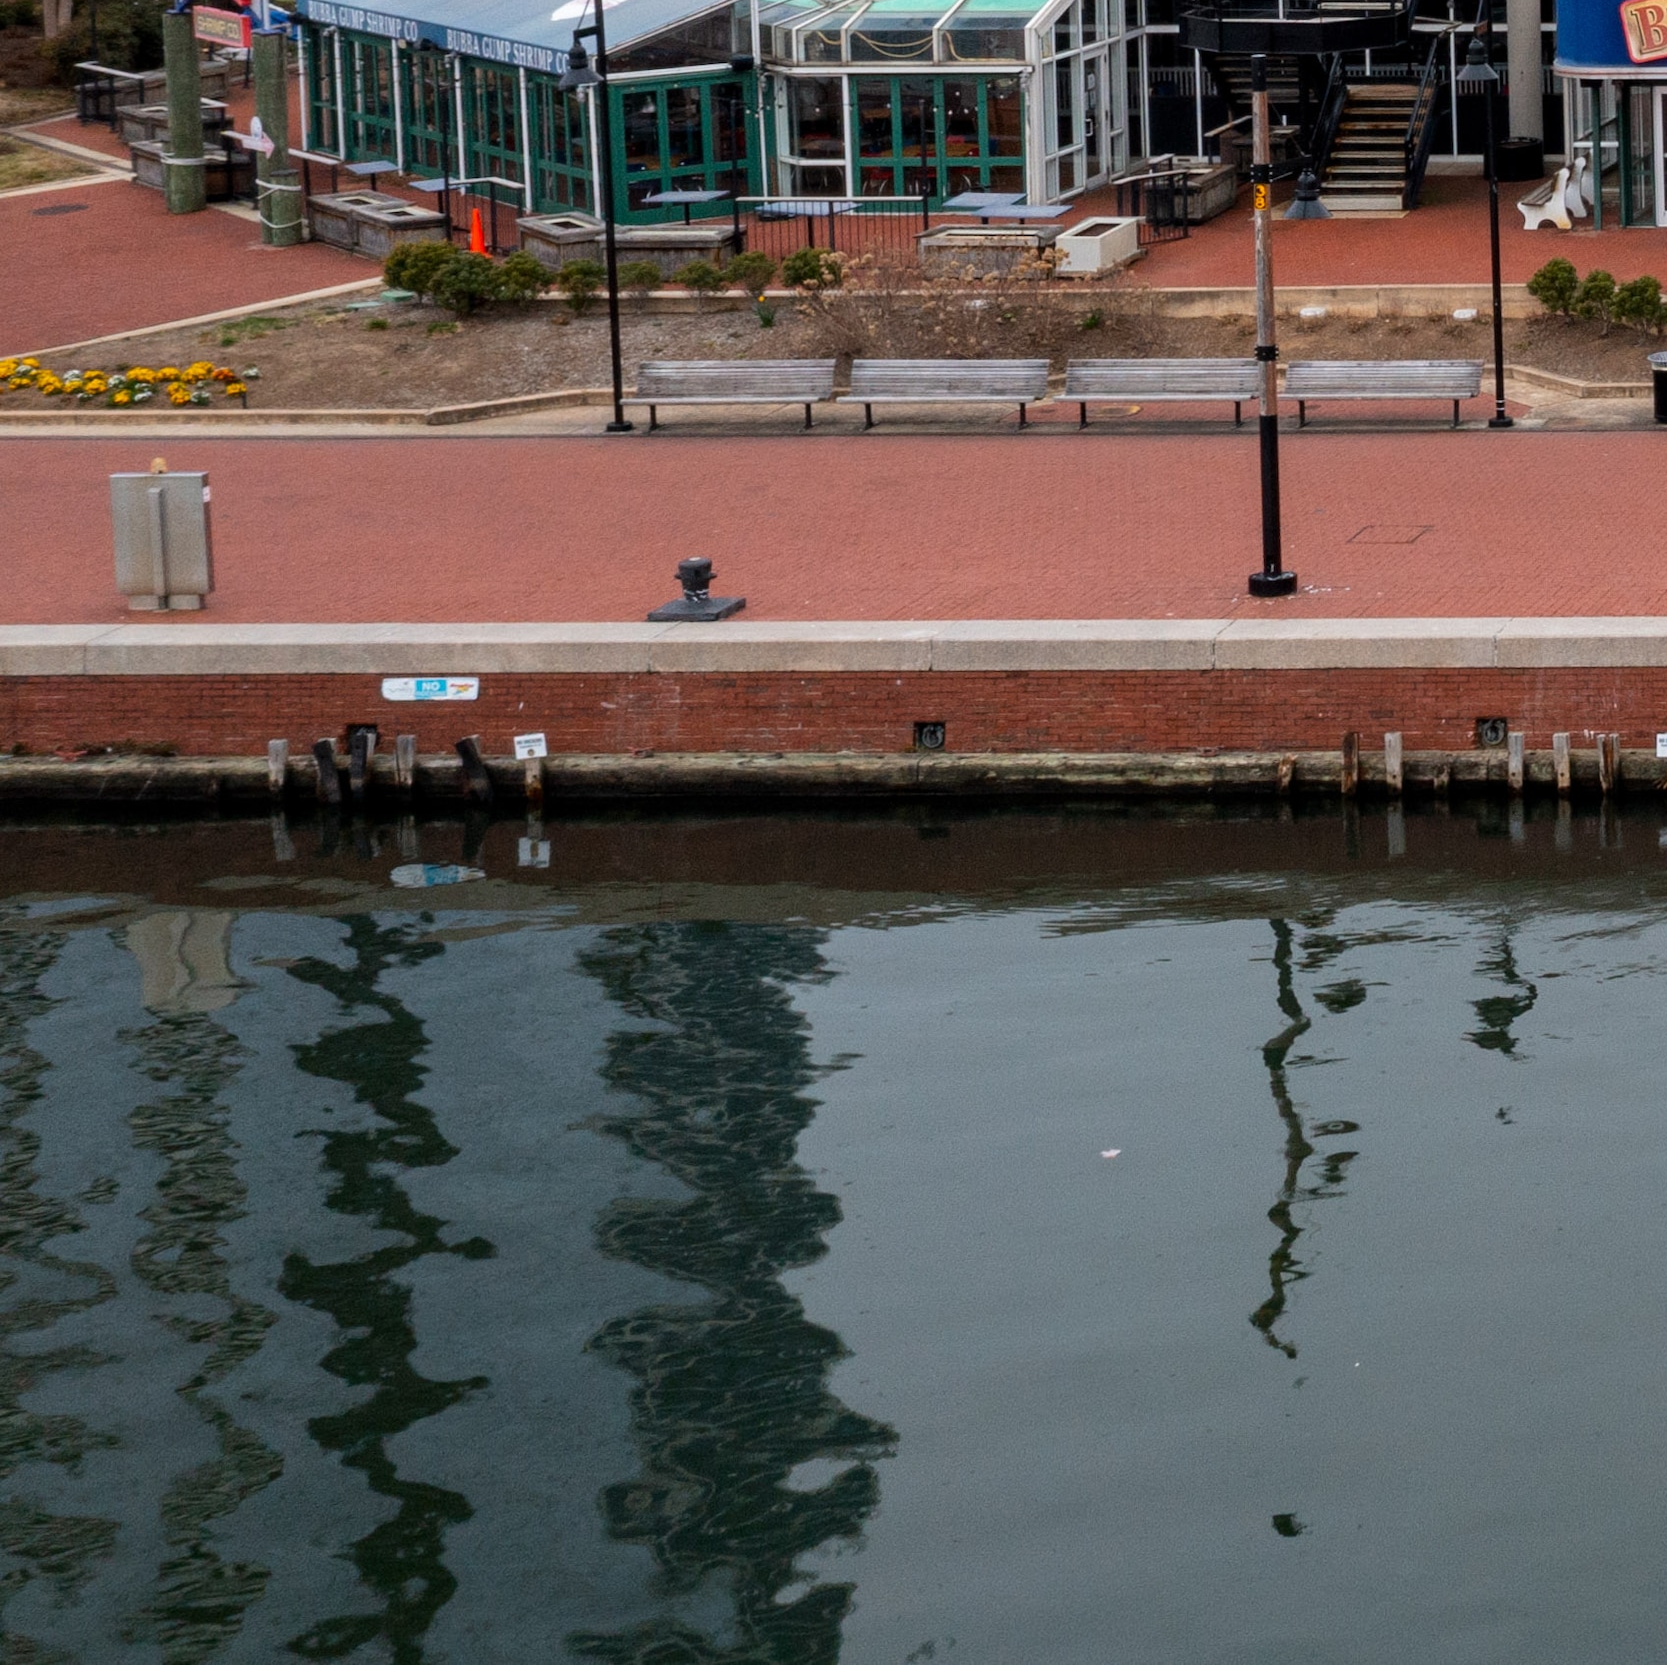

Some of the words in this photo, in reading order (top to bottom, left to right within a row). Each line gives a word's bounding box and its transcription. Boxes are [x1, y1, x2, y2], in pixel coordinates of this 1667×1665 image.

[197, 16, 226, 35] SHRIMP
[308, 0, 336, 23] BUBBA
[338, 6, 365, 29] GUMP
[366, 12, 402, 39] SHRIMP
[446, 29, 479, 54] BUBBA
[481, 37, 511, 62] GUMP
[513, 45, 553, 72] SHRIMP
[1255, 184, 1266, 209] 38
[422, 682, 440, 691] NO
